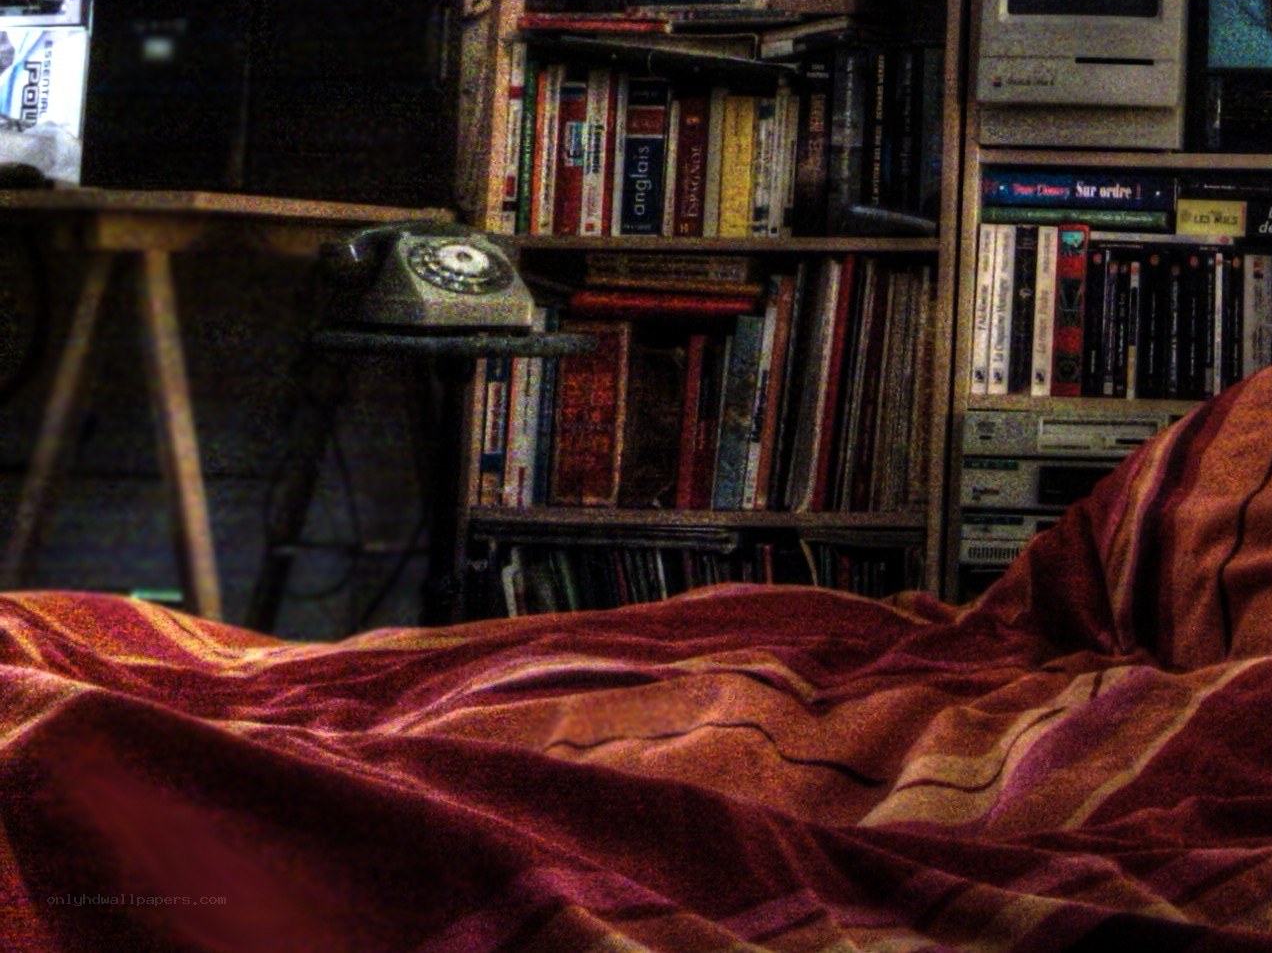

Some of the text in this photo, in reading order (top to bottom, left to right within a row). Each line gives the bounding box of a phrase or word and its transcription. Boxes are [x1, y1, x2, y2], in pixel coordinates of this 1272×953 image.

[629, 144, 654, 217] anglais
[1075, 180, 1096, 198] Sur
[1098, 181, 1133, 198] ordre
